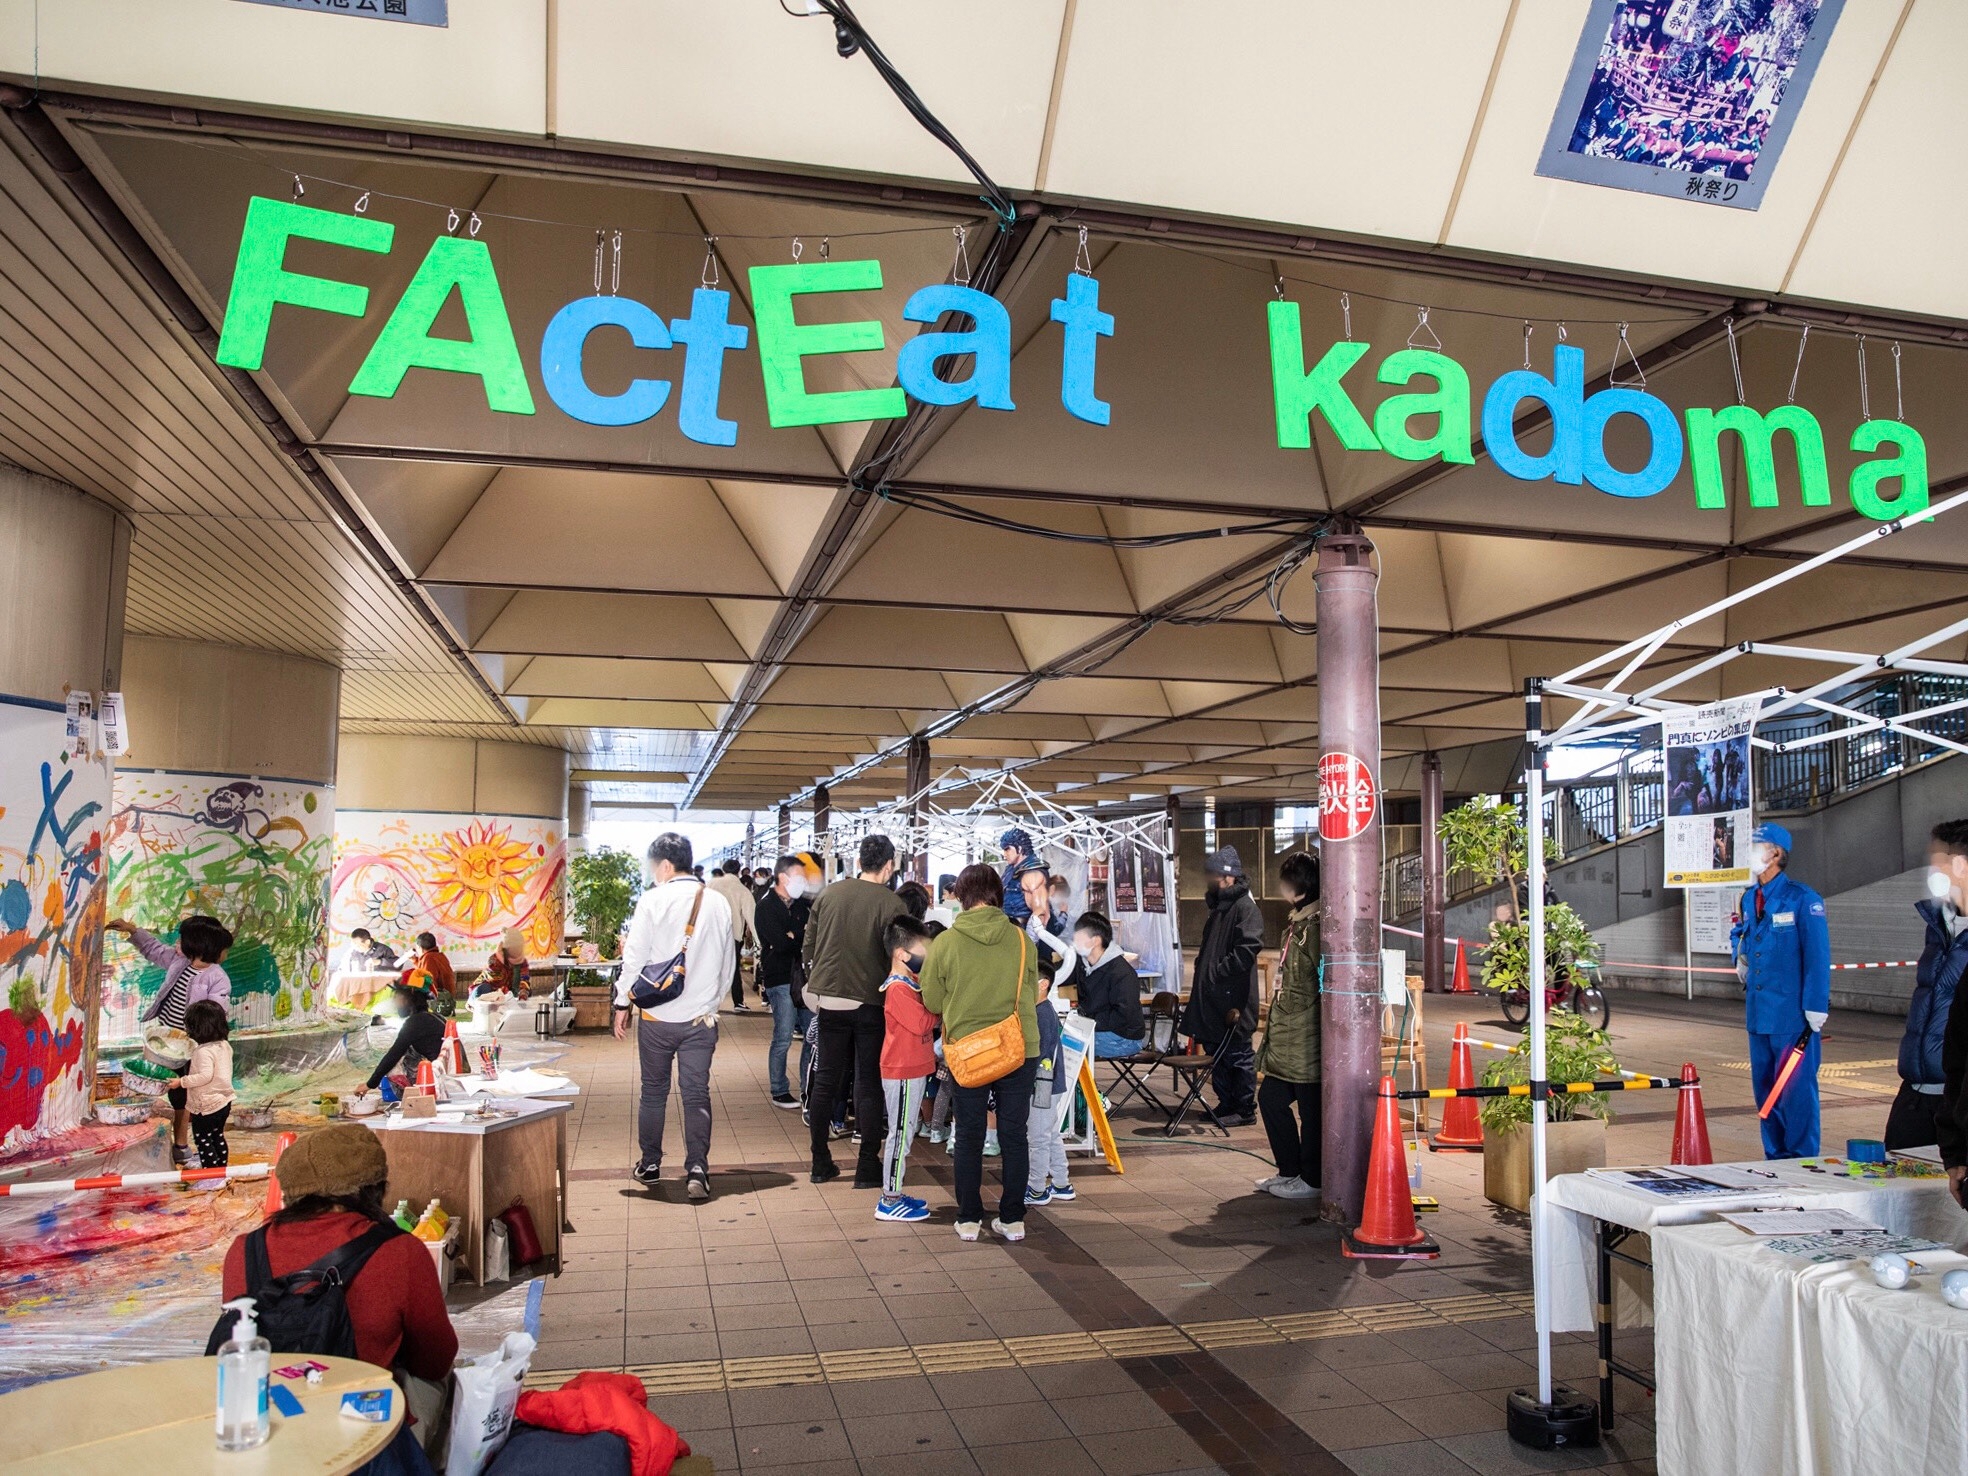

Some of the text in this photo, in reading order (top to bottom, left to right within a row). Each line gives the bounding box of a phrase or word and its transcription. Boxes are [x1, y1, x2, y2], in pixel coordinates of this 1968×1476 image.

[1685, 176, 1739, 202] 秋祭り
[1266, 301, 1934, 523] kadoma
[1667, 719, 1752, 746] 門真にゾンビの集団
